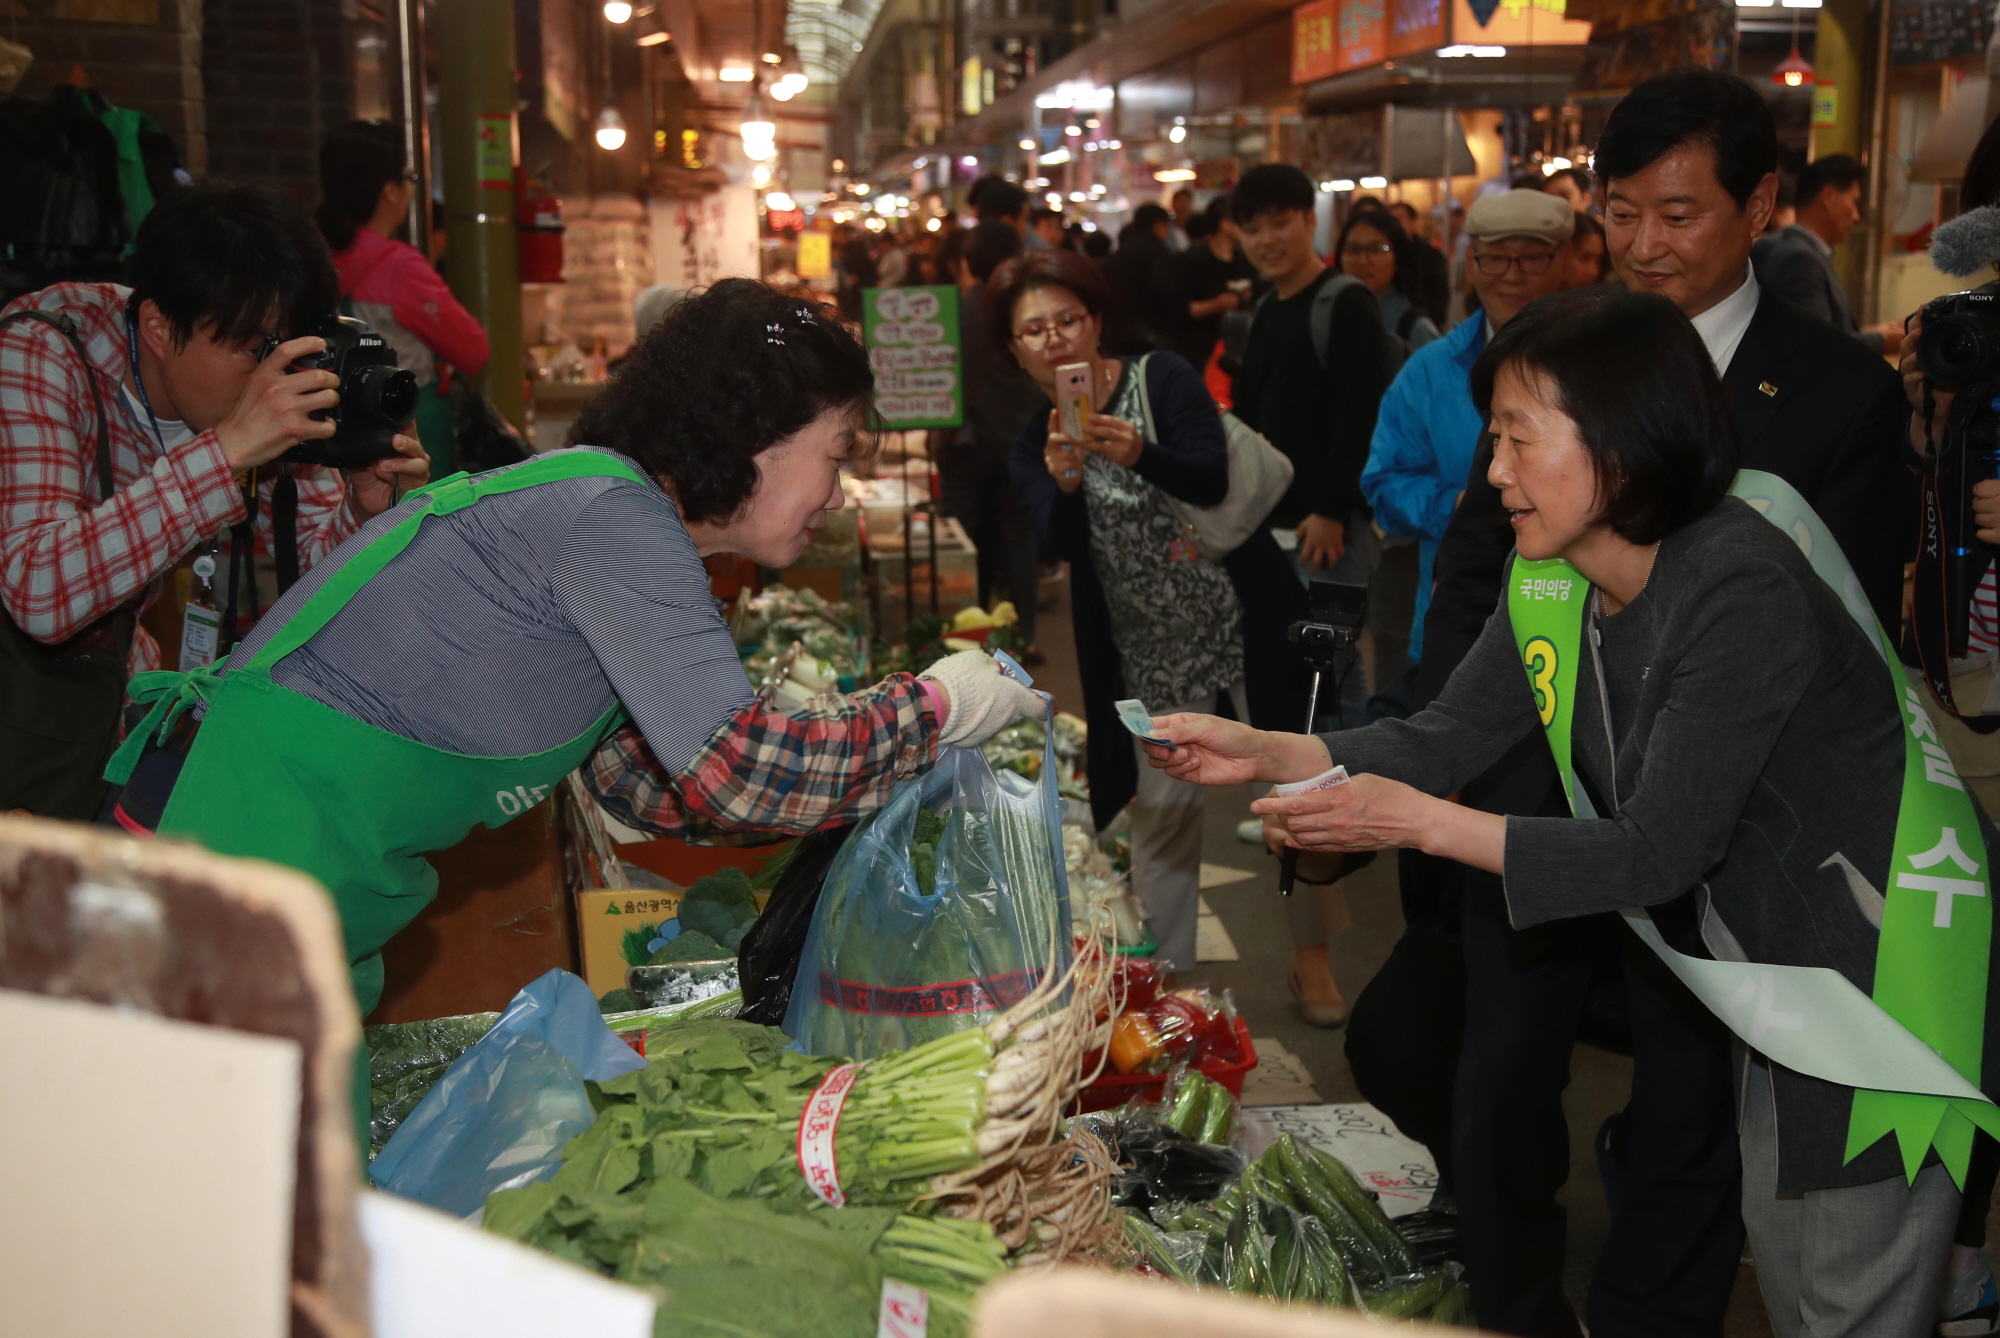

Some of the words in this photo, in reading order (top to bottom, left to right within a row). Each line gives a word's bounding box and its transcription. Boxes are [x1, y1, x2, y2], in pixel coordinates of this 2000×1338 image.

[359, 338, 382, 346] Nikon
[1926, 490, 1937, 558] SONY
[1519, 578, 1573, 601] 국민의당
[1524, 635, 1559, 730] 3
[1319, 774, 1344, 790] 5000
